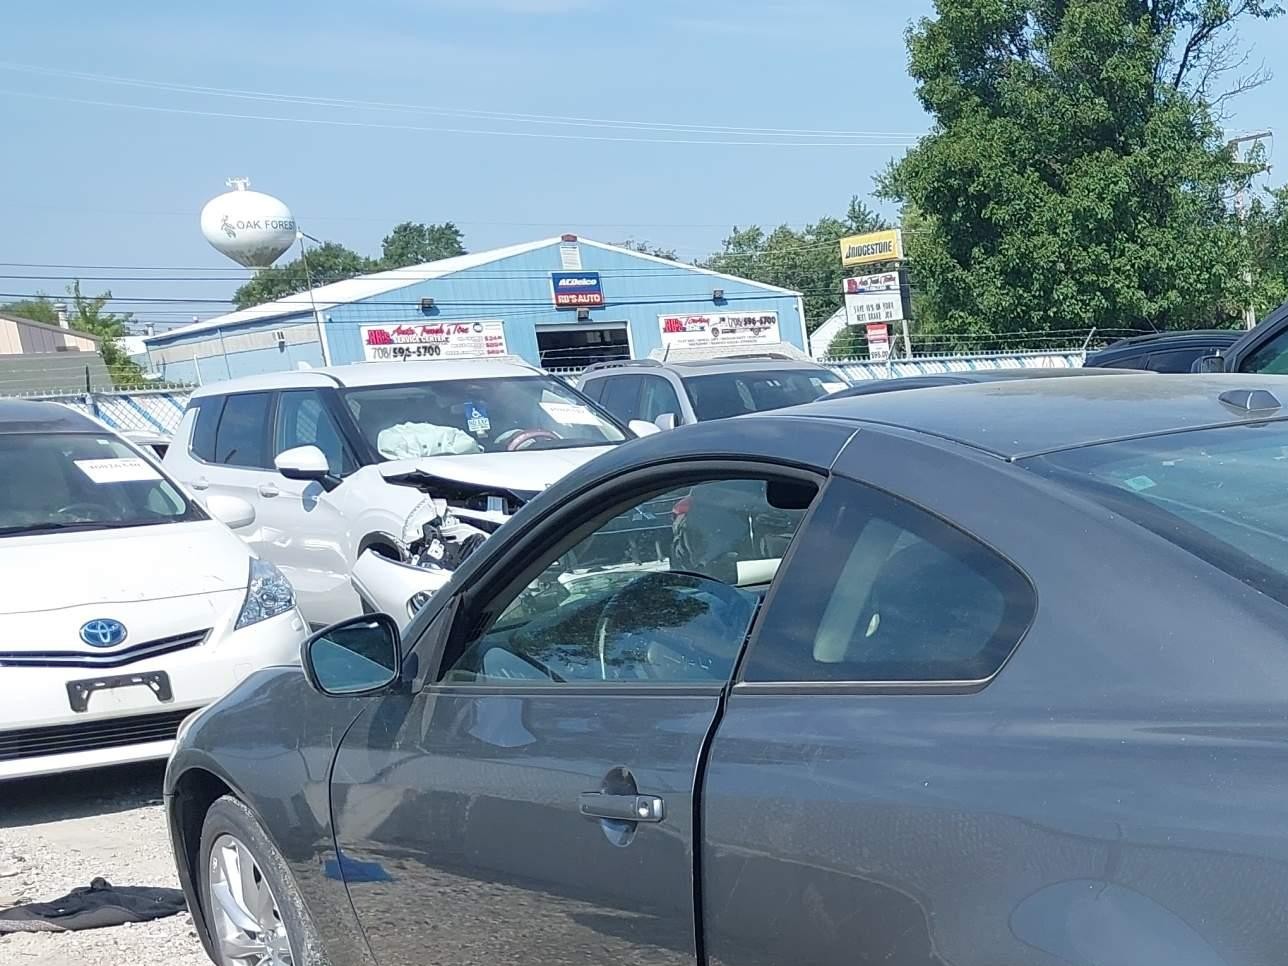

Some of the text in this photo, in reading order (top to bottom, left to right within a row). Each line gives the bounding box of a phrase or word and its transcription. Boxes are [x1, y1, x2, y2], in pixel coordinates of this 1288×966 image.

[236, 220, 295, 230] OAK FOREST
[846, 241, 892, 259] BRIDGESTONE
[578, 294, 600, 303] AUTO
